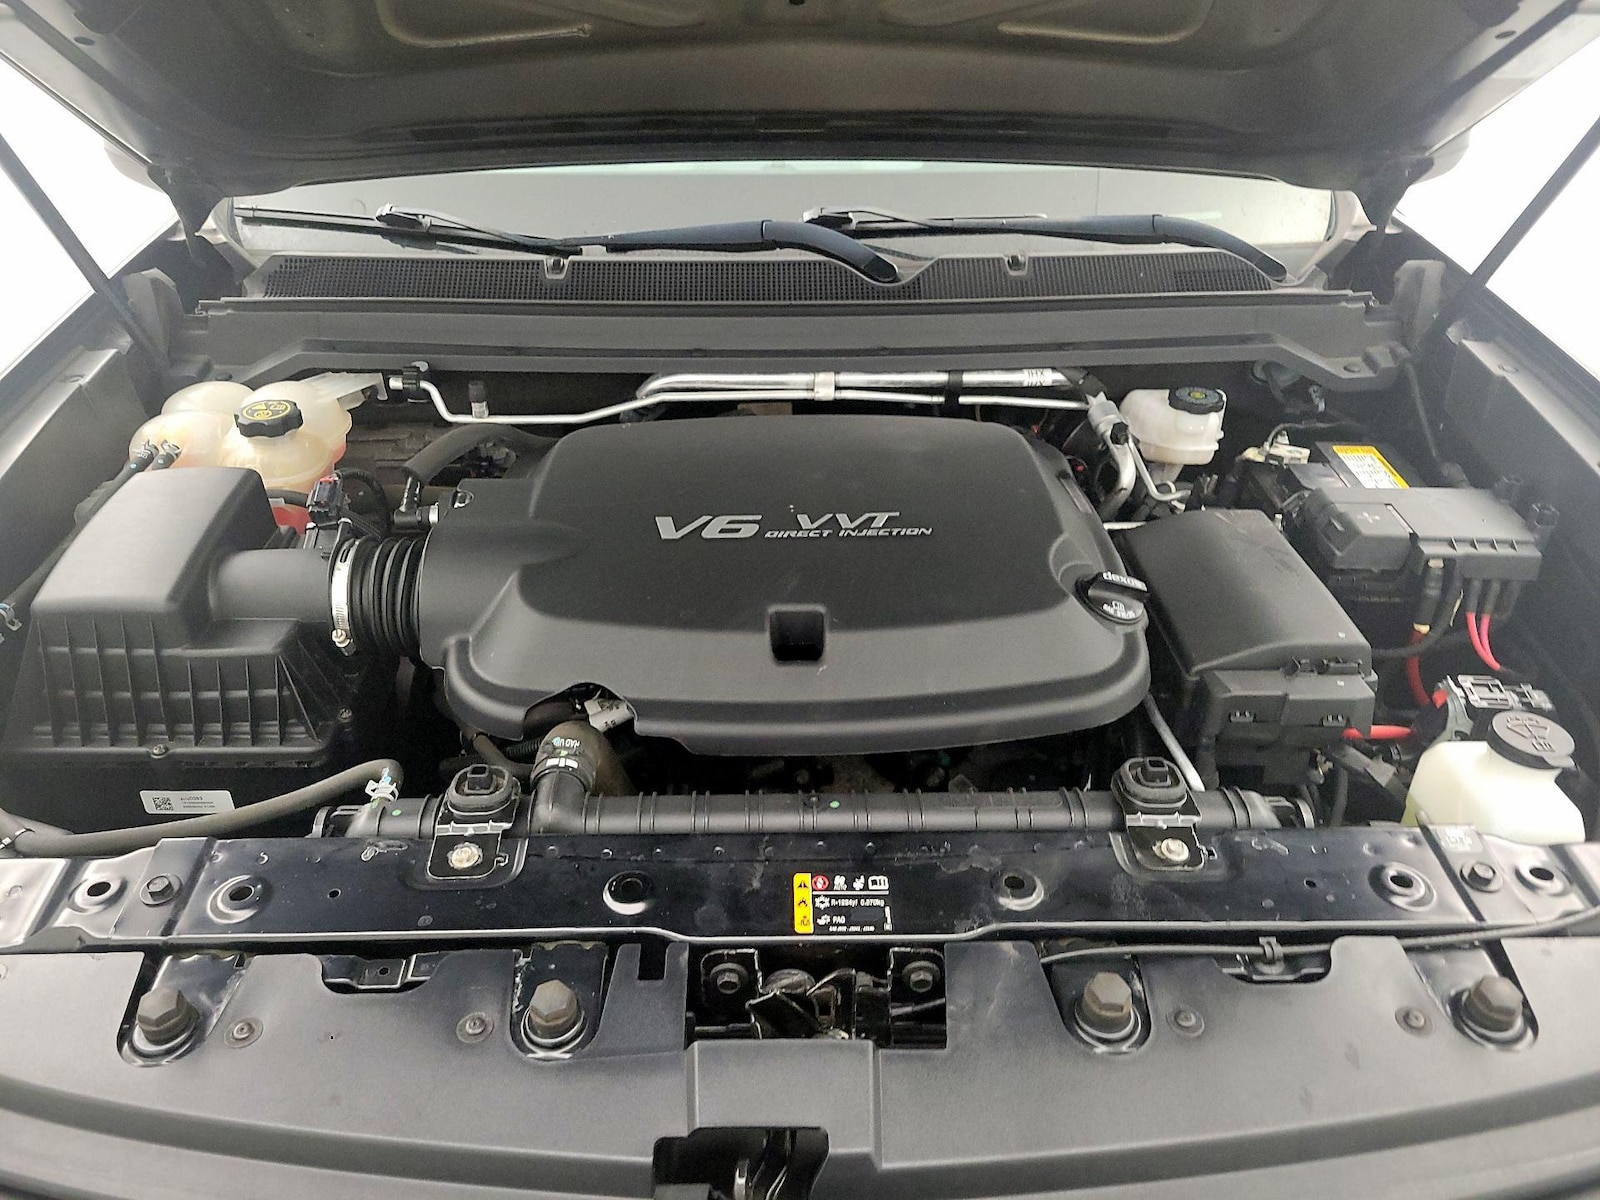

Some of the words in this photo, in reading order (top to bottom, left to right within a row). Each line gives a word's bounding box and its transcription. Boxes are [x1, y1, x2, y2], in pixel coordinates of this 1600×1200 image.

[655, 514, 763, 540] V6
[797, 511, 900, 530] VVT
[764, 529, 833, 538] DIRECT
[838, 527, 933, 538] INJECTION
